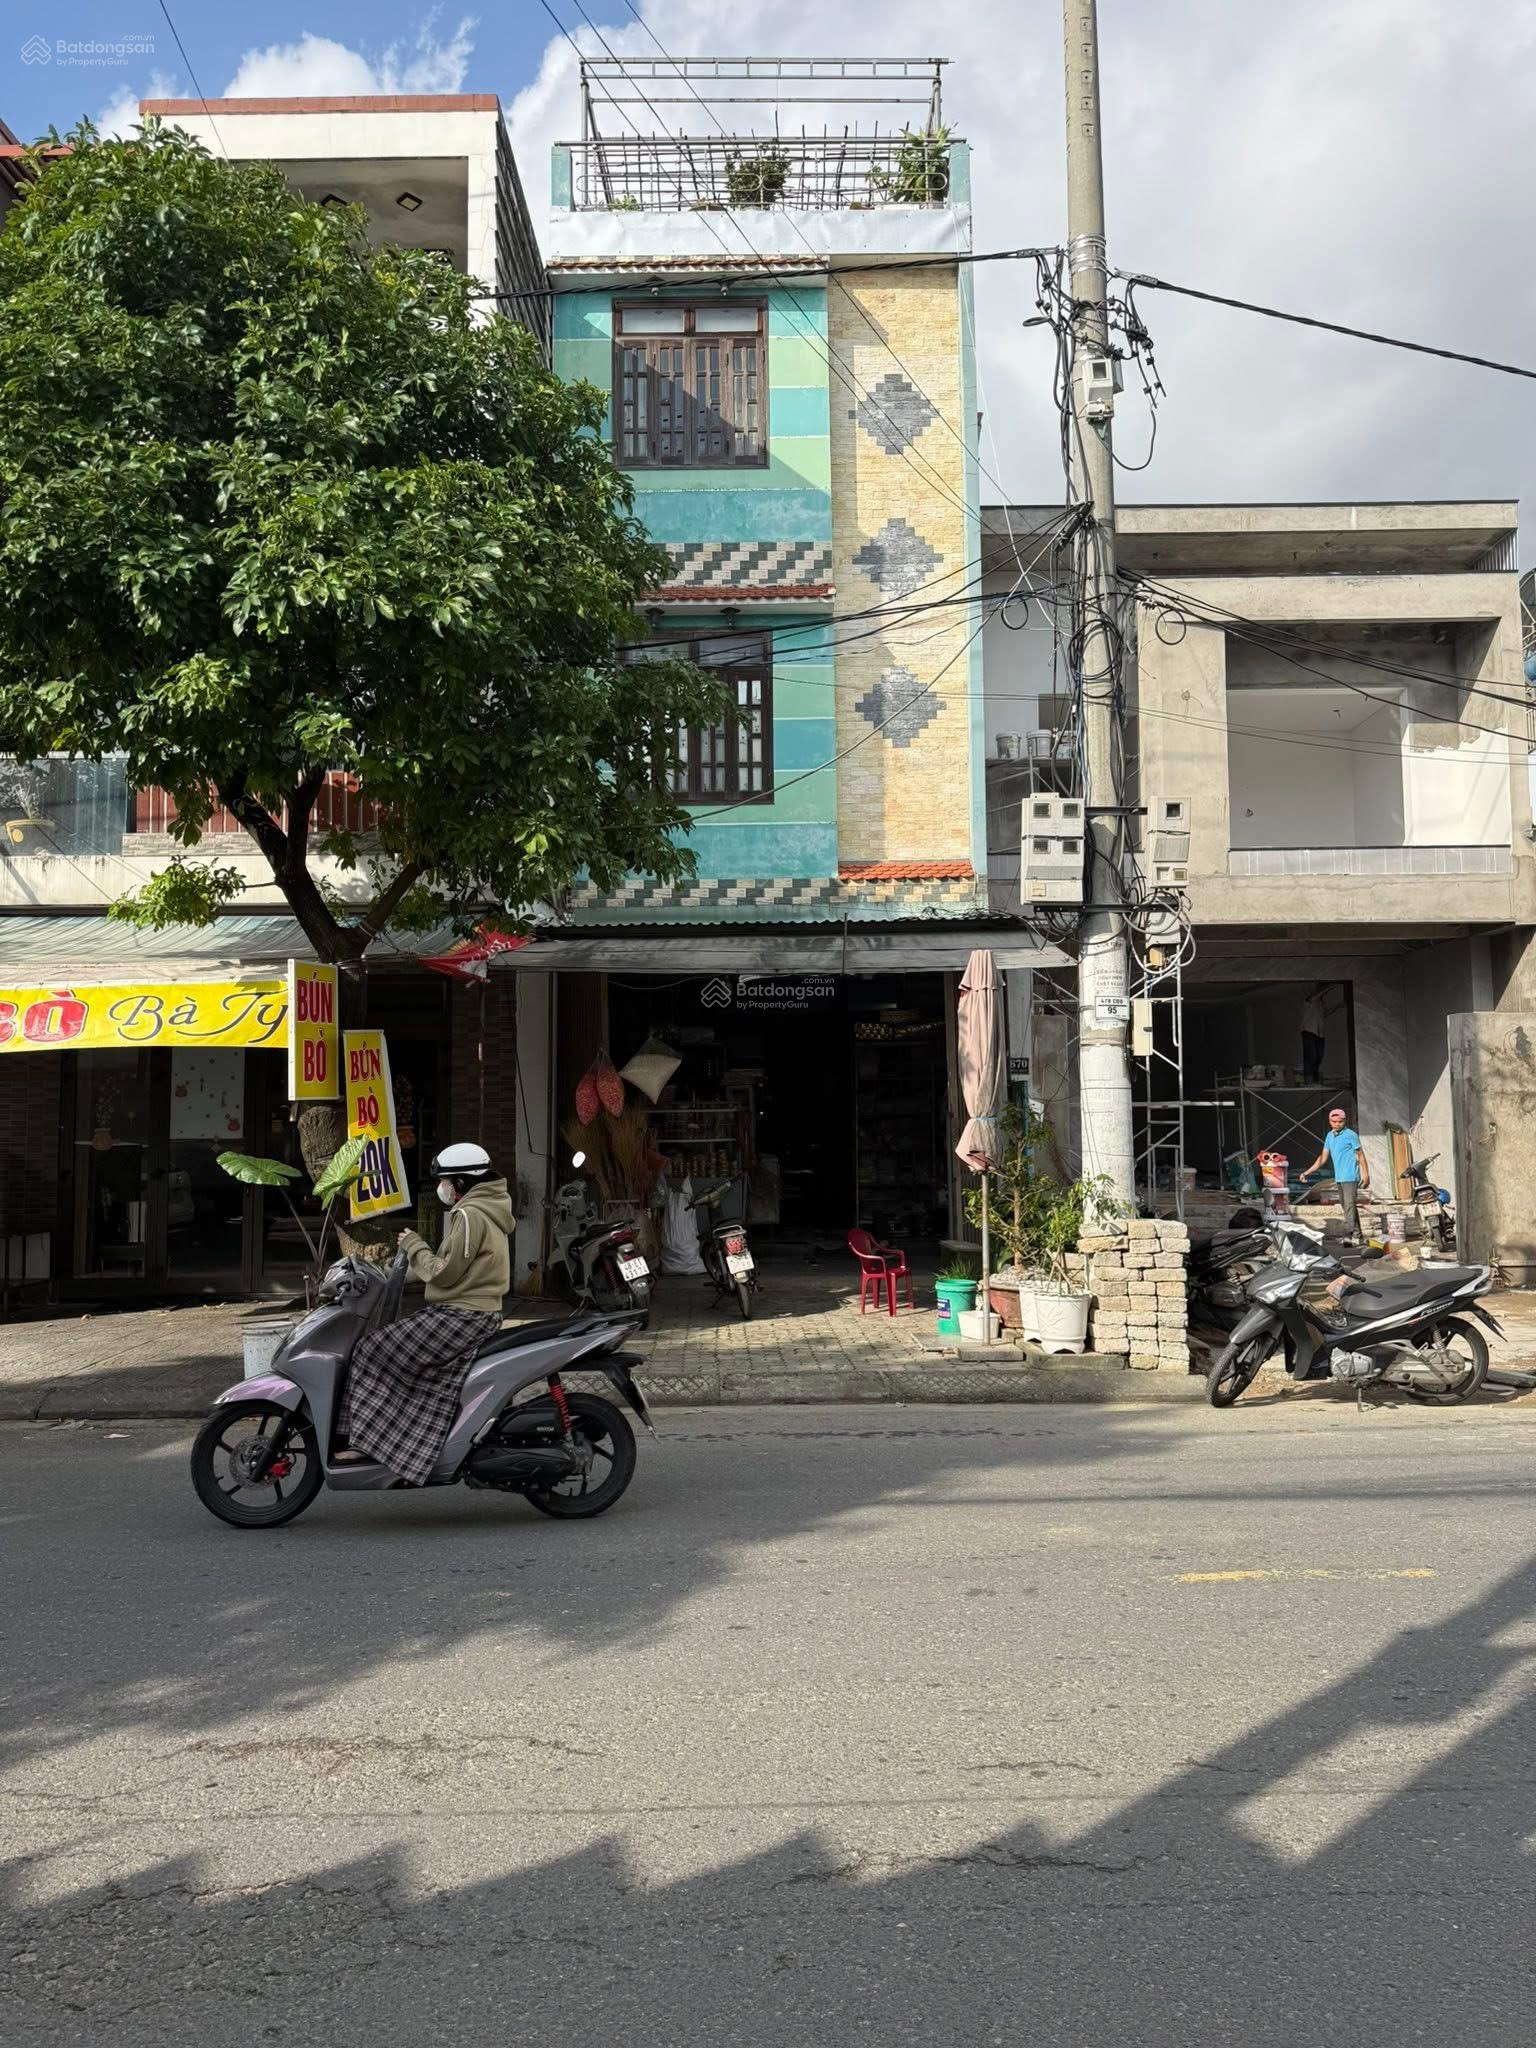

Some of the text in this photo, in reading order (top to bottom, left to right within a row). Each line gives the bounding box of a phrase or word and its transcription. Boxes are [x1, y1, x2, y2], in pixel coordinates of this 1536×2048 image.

[0, 990, 90, 1043] Ò
[108, 995, 199, 1042] Bà
[296, 970, 333, 1024] BÚN
[1107, 1006, 1118, 1014] 95
[304, 1029, 328, 1082] BÒ
[349, 1040, 382, 1083] BÚN
[356, 1087, 380, 1128] BÒ
